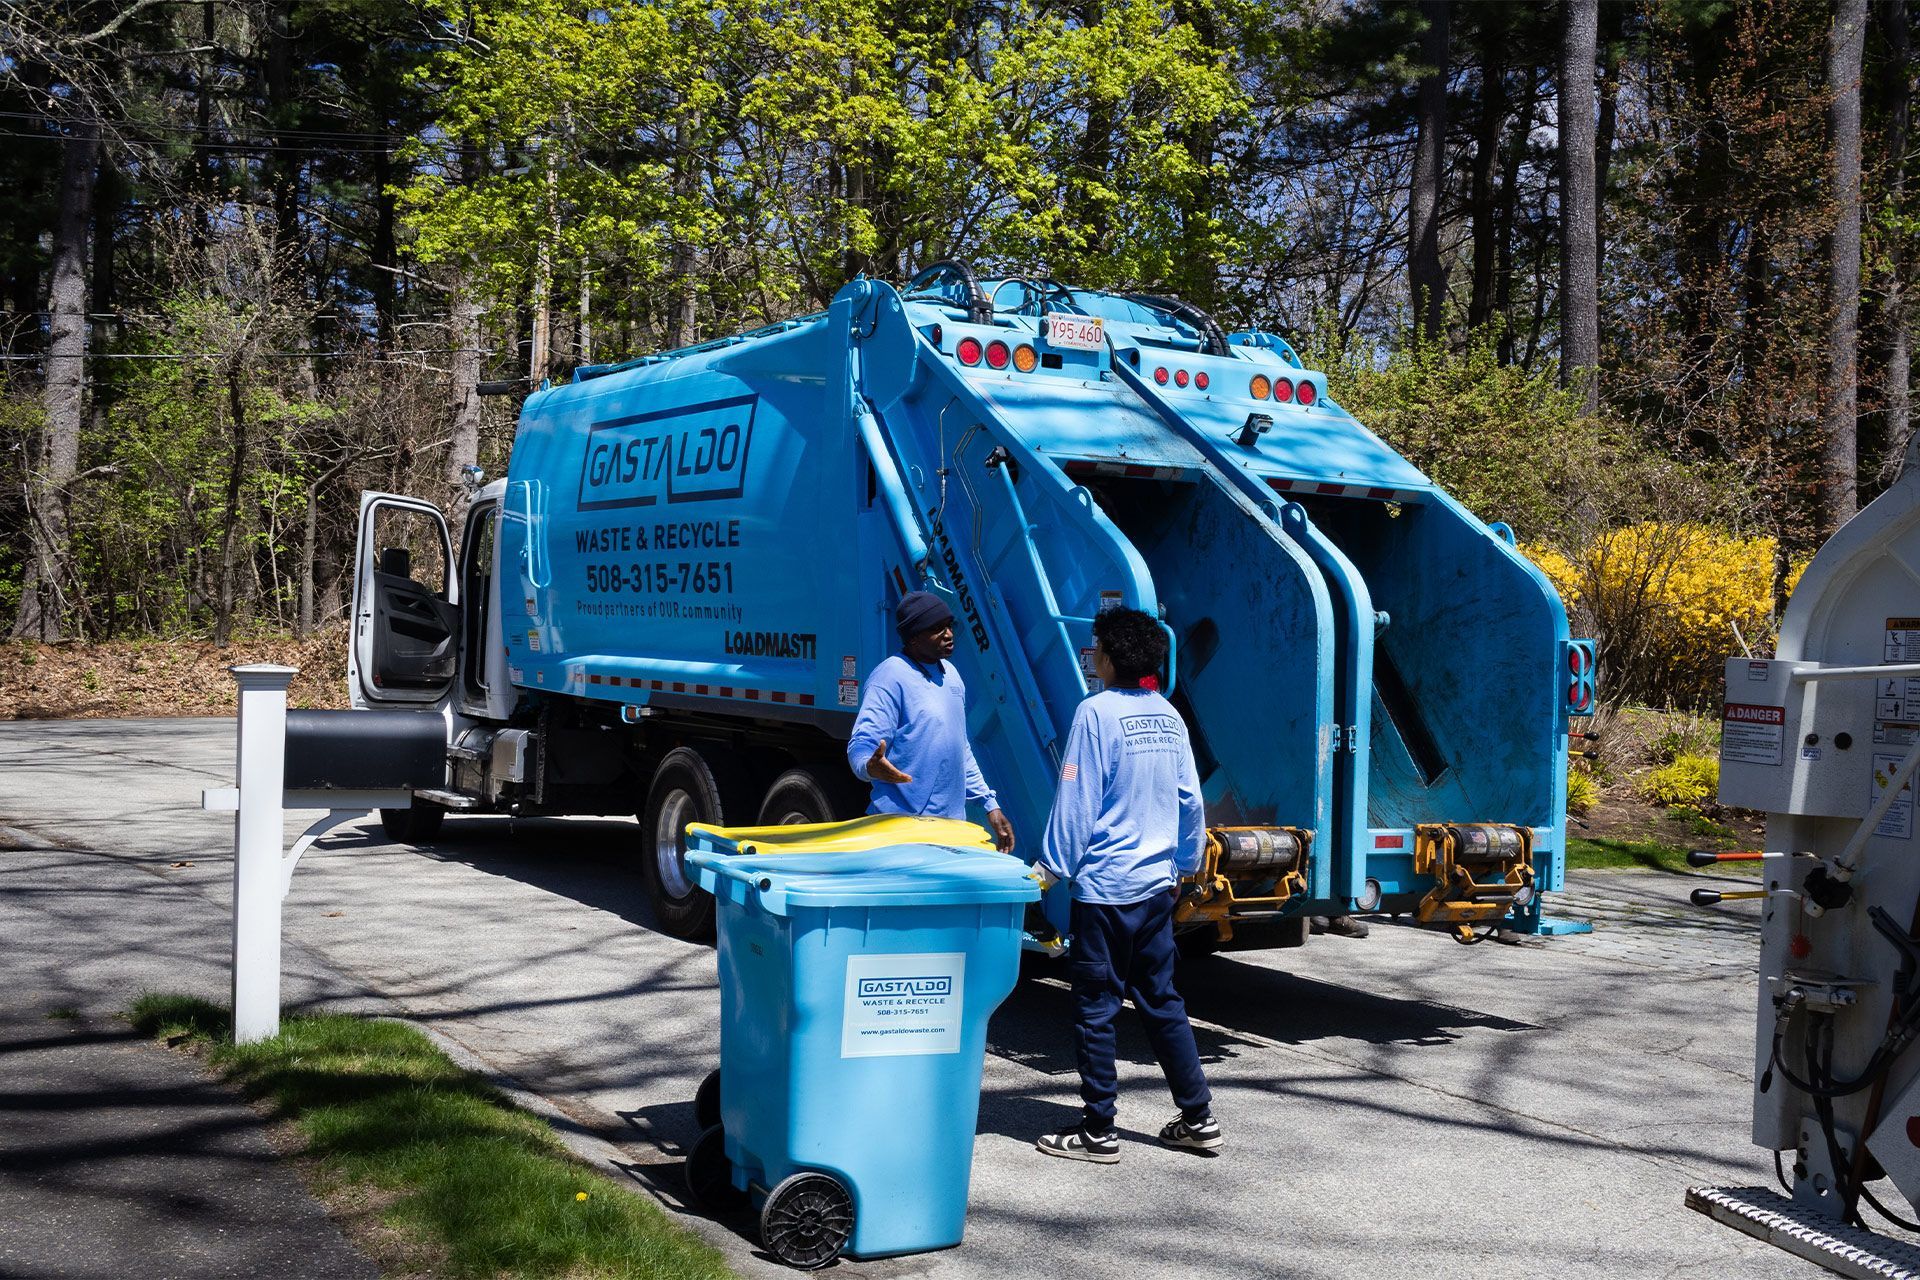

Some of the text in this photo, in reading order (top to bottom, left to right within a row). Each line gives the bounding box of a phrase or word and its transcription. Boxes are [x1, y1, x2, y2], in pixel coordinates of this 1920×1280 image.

[589, 424, 741, 487] GASTALDO
[575, 519, 740, 553] WASTE & RECYCLE
[586, 562, 733, 593] 508-315-7651
[577, 600, 743, 624] Proud partners of OUR community
[1737, 707, 1781, 722] DANGER
[1126, 737, 1151, 747] WASTE
[864, 981, 947, 993] GASTALDO
[877, 1008, 929, 1016] 508-315-7651
[860, 1027, 945, 1036] www.gastaldowaste.com
